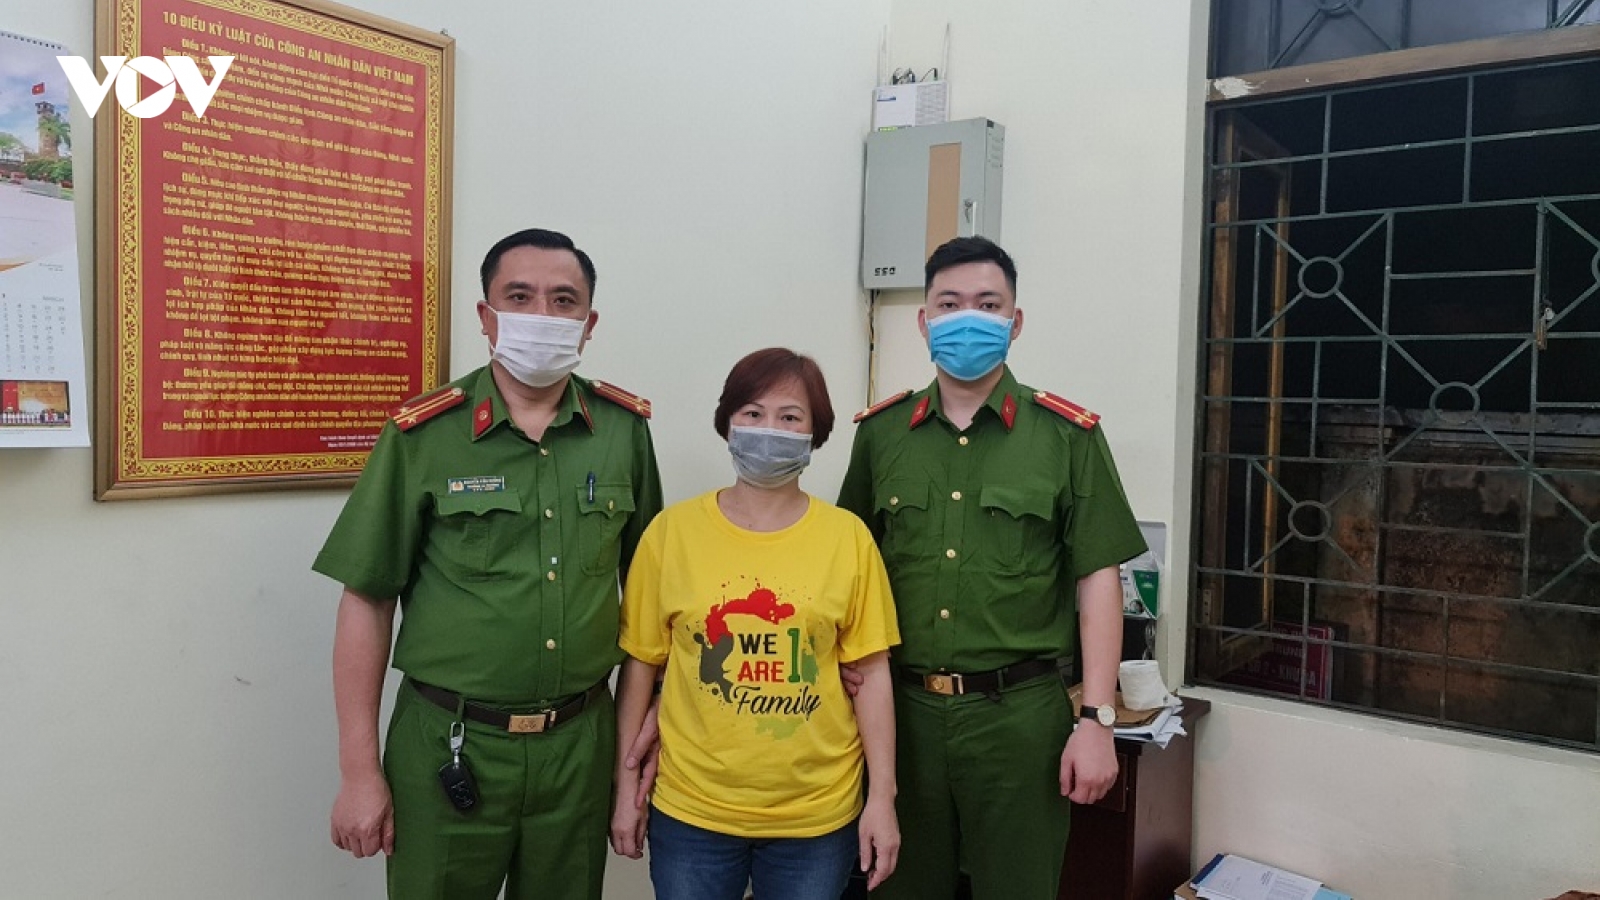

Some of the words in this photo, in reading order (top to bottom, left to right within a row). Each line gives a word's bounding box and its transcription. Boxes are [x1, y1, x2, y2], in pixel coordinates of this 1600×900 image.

[163, 9, 176, 25] 10
[180, 10, 205, 33] ĐIỀU
[225, 25, 251, 44] LUẬT
[254, 30, 274, 50] CỦA
[278, 38, 304, 57] CÔNG
[308, 47, 320, 61] AN
[324, 50, 350, 69] NHÂN
[352, 57, 371, 74] DÂN
[374, 63, 391, 79] VIỆT
[394, 70, 413, 84] NAM
[204, 409, 215, 417] 10.
[737, 661, 784, 682] ARE
[738, 633, 778, 655] WE
[787, 628, 801, 682] 1
[733, 685, 821, 721] Family
